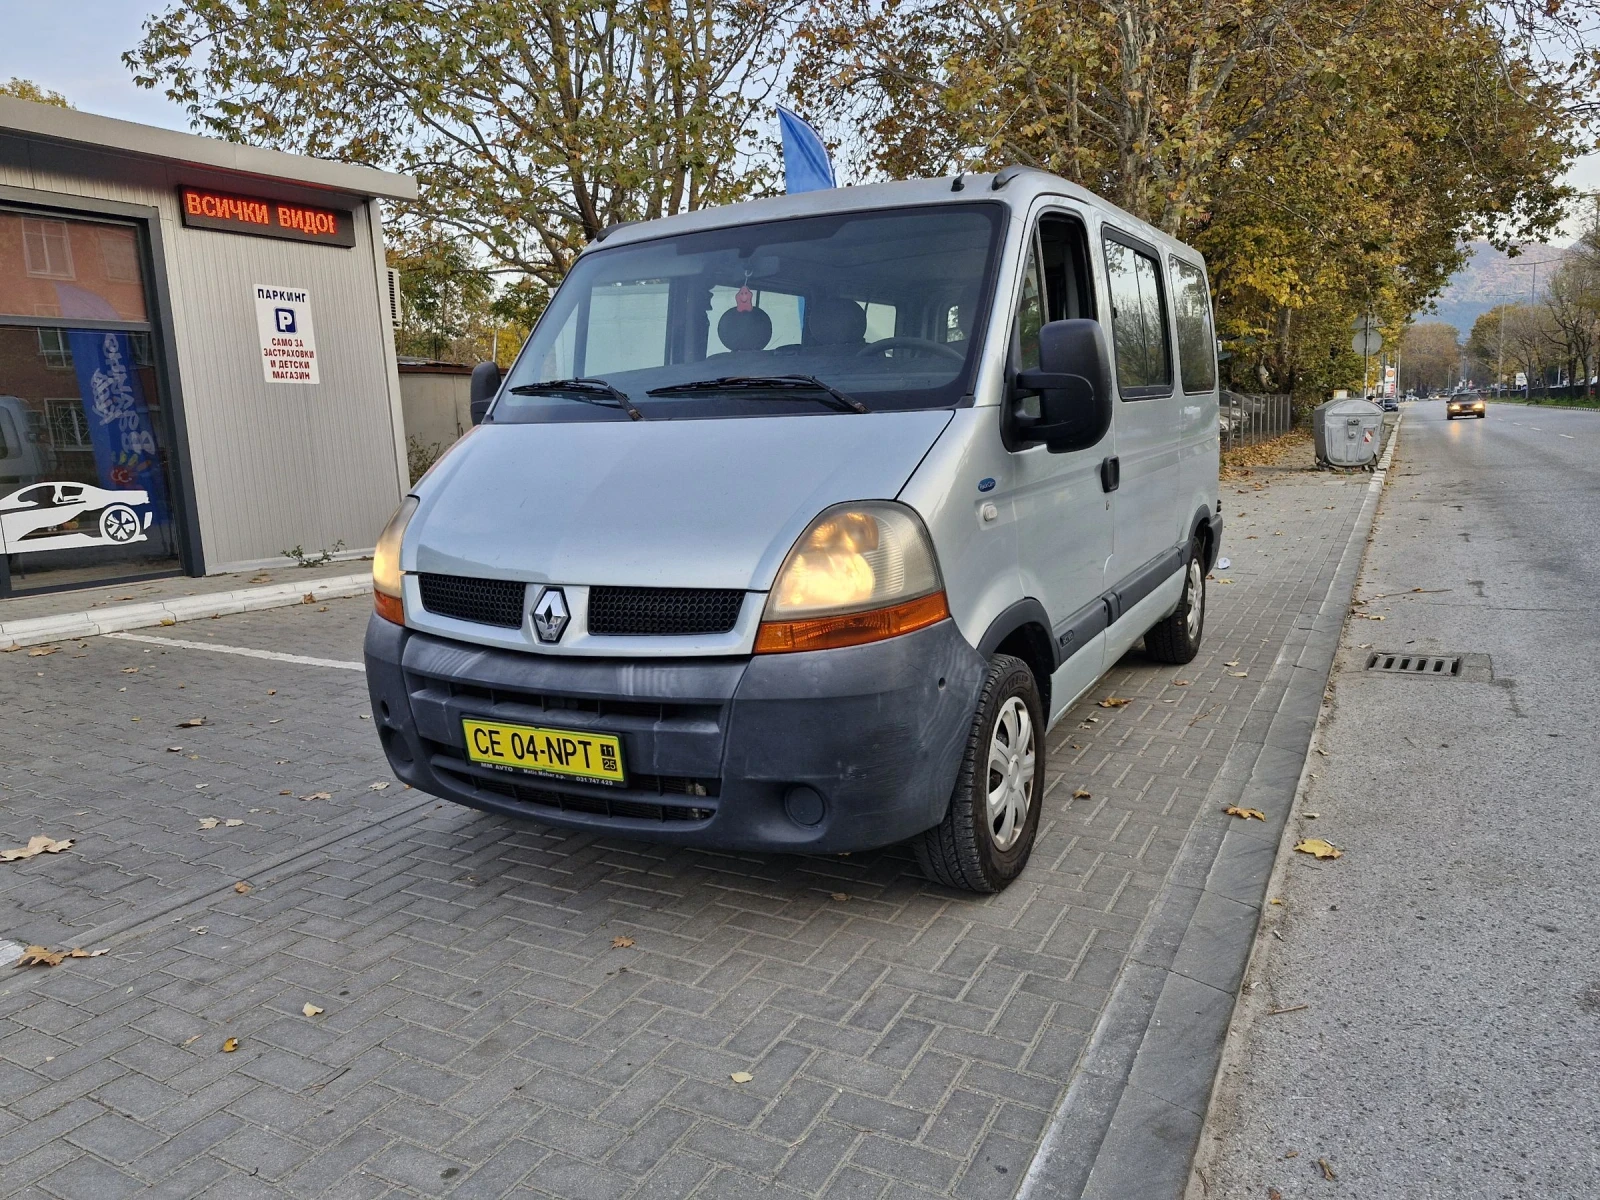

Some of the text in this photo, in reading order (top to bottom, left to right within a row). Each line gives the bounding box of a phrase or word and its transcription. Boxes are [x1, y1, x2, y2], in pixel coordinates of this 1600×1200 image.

[186, 193, 269, 225] ВСИЧКИ
[257, 288, 306, 303] ПАРКИНГ
[278, 311, 293, 331] P
[271, 338, 304, 348] САМО ЗА
[263, 348, 315, 359] ЗАСТРАХОВКИ
[270, 360, 310, 369] И ДЕТСКИ
[272, 371, 311, 380] МАГАЗИН
[474, 727, 592, 769] CE 04-NPT
[602, 746, 613, 756] 11
[495, 764, 513, 772] AVTO
[603, 759, 616, 770] 25
